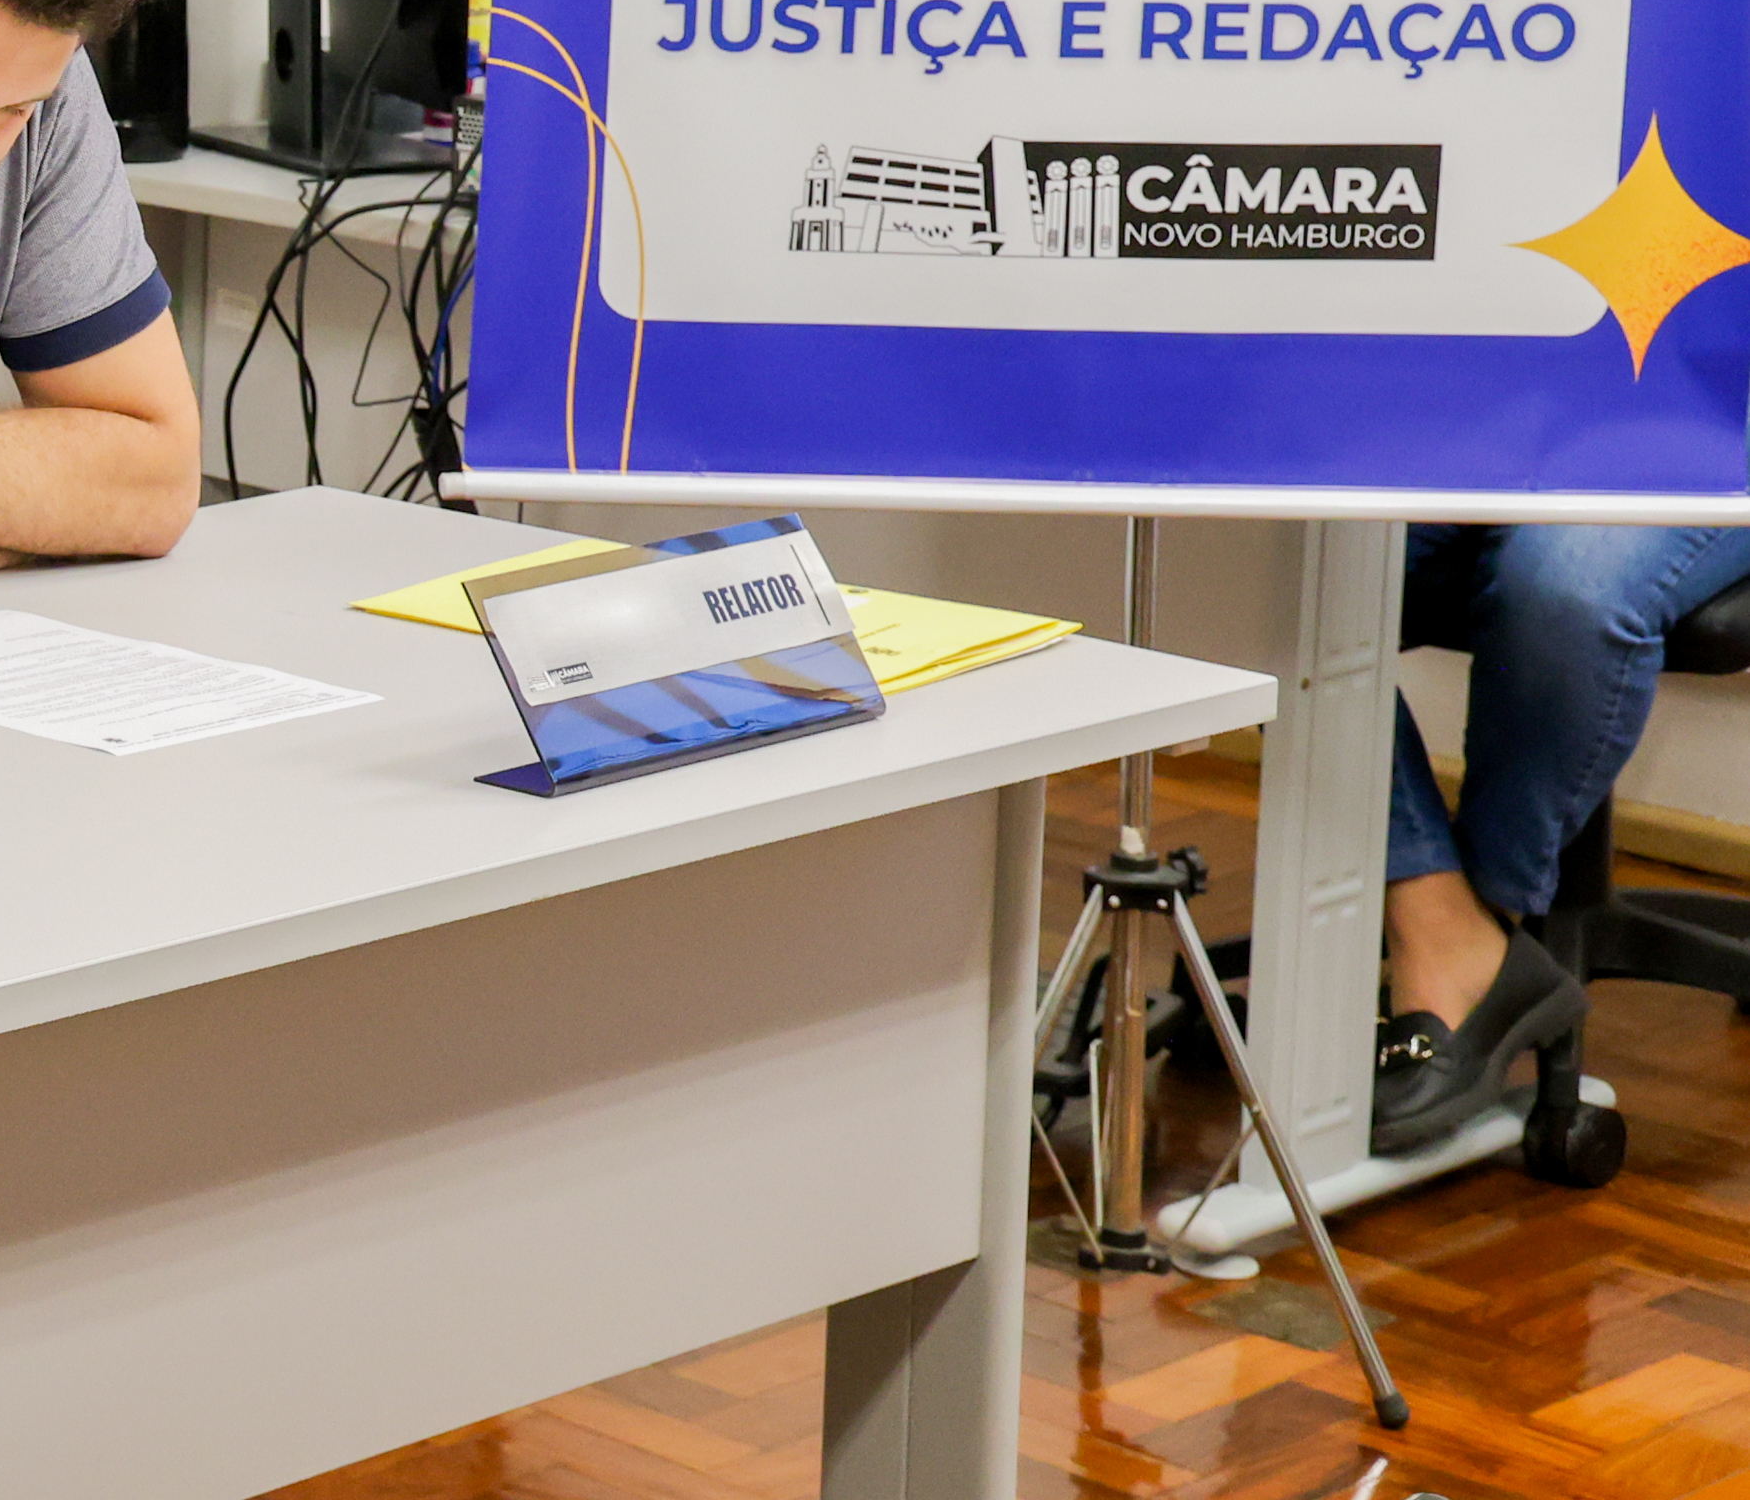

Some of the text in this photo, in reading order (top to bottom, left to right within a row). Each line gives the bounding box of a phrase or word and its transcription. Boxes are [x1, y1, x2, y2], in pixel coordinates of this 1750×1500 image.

[1060, 0, 1106, 59] E
[1126, 154, 1428, 214] CÂMARA
[1124, 222, 1425, 249] NOVO HAMBURGO
[702, 573, 805, 625] RELATOR
